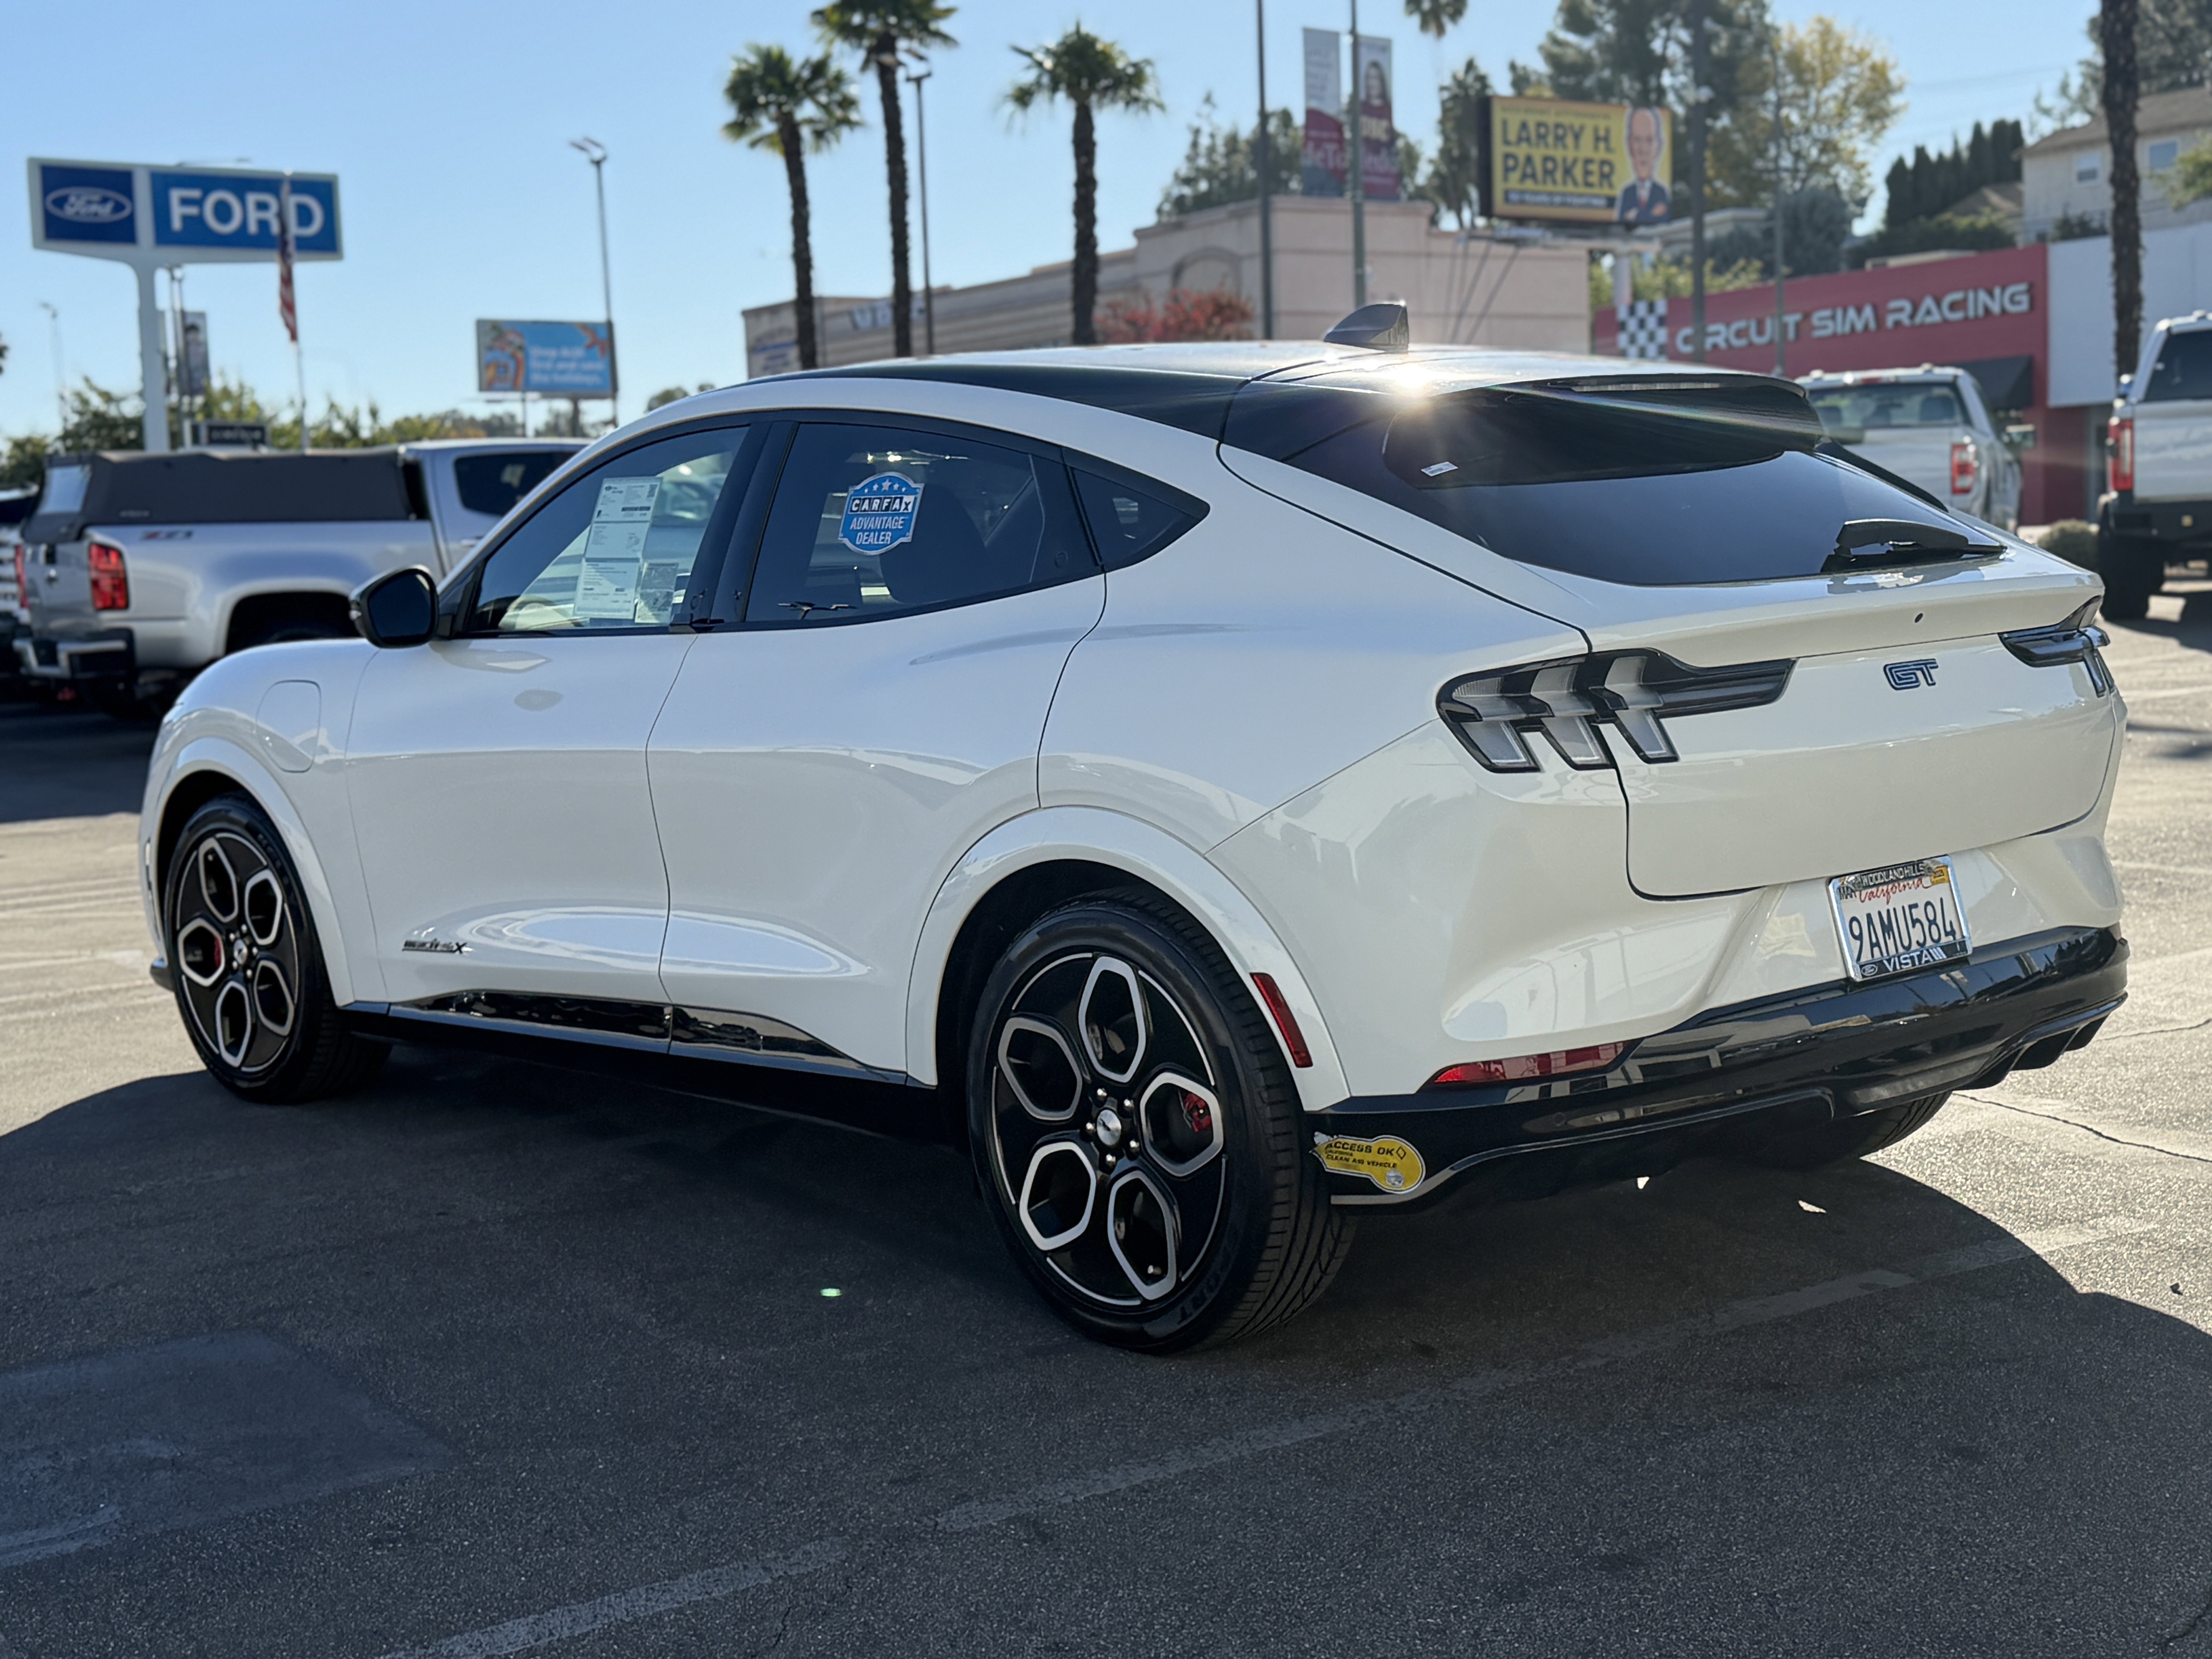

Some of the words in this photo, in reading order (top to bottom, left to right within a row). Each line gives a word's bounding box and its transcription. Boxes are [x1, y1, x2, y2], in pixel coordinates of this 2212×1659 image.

[1503, 118, 1585, 151] LARRY
[1593, 125, 1616, 153] H.
[1504, 153, 1614, 189] PARKER
[168, 188, 325, 237] FORD
[1811, 303, 1877, 338] SIM
[1885, 282, 2031, 330] RACING
[852, 498, 912, 512] CARFAX
[850, 517, 905, 530] ADVANTAGE
[856, 531, 892, 544] DEALER
[1883, 658, 1938, 690] GT
[1859, 877, 1932, 905] California
[1848, 897, 1956, 962] 9AMU584
[1883, 949, 1933, 972] VISTA
[1325, 1141, 1372, 1153] ACCESS
[1377, 1147, 1394, 1156] OK
[1326, 1154, 1350, 1162] CLEAN
[1367, 1160, 1397, 1168] VEHICLE
